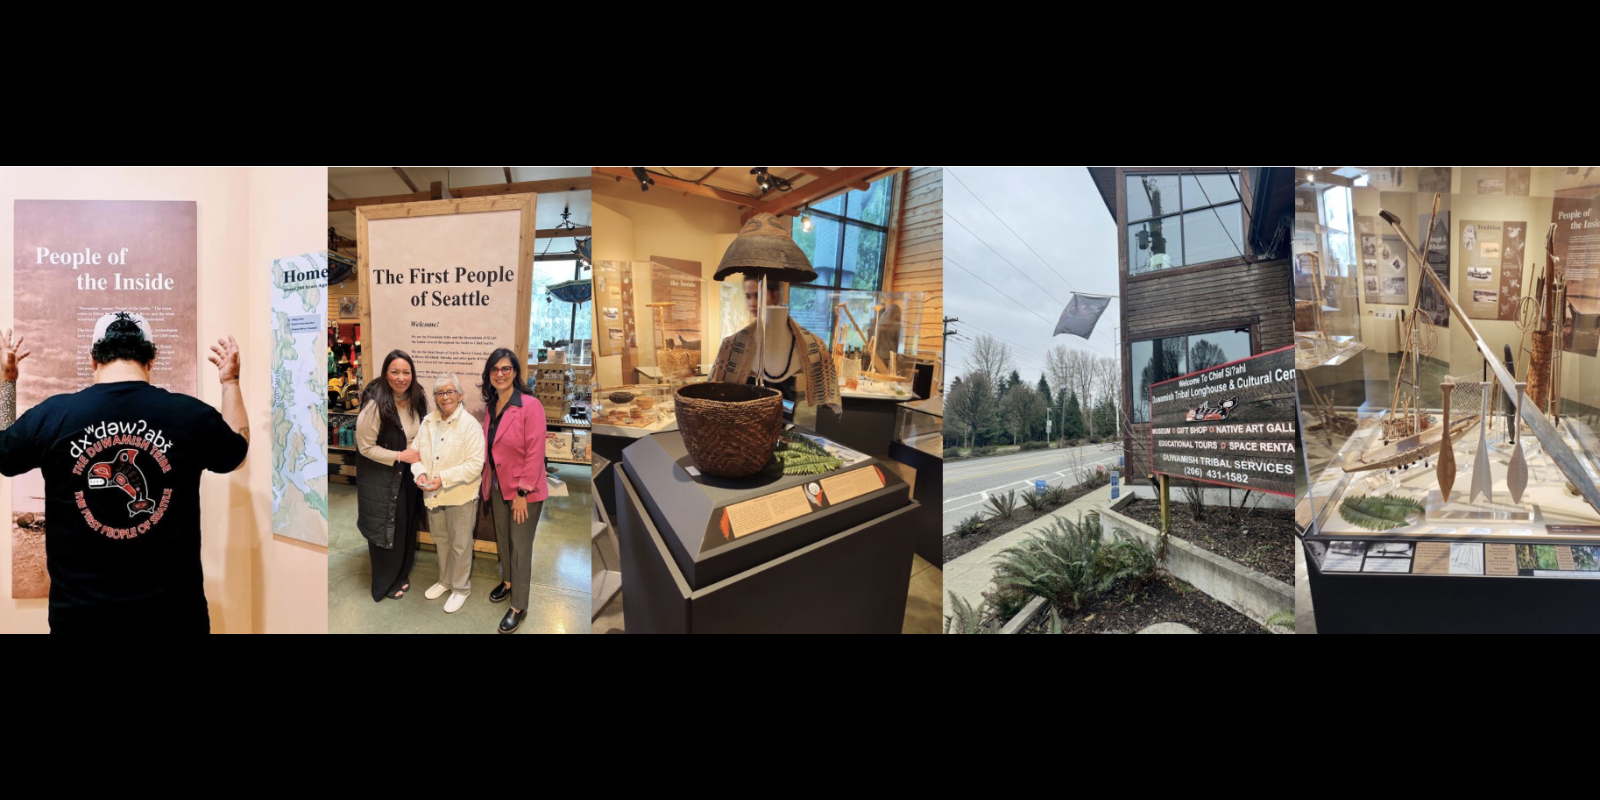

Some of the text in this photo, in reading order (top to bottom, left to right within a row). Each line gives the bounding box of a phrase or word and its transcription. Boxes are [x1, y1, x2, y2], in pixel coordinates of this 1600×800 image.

[1558, 208, 1592, 222] People of
[1571, 221, 1582, 229] the
[36, 247, 128, 270] People of
[77, 273, 174, 290] the Inside
[284, 268, 328, 284] Home
[373, 266, 514, 287] The First People
[411, 290, 490, 306] of Seattle
[1179, 378, 1200, 387] Welcome
[1202, 374, 1208, 382] To
[1209, 370, 1224, 381] Chief
[1152, 392, 1174, 404] Duwamish
[1175, 388, 1189, 400] Tribal
[1191, 383, 1228, 397] Longhouse
[1229, 379, 1235, 390] &
[1237, 371, 1272, 388] Cultural
[1216, 425, 1244, 433] NATIVE
[1246, 424, 1264, 433] ART
[1266, 423, 1295, 433] GALL
[72, 434, 172, 475] THE DUWAMISH TRIBE
[1158, 440, 1295, 453] EDUCATIONAL TOURS SPACE RENTA
[1163, 453, 1294, 474] DUWAMISH TRIBAL SERVICES
[1184, 466, 1248, 484] (206) 431-1582
[74, 488, 172, 539] THE FIRST PEOPLE OF SEATTLE
